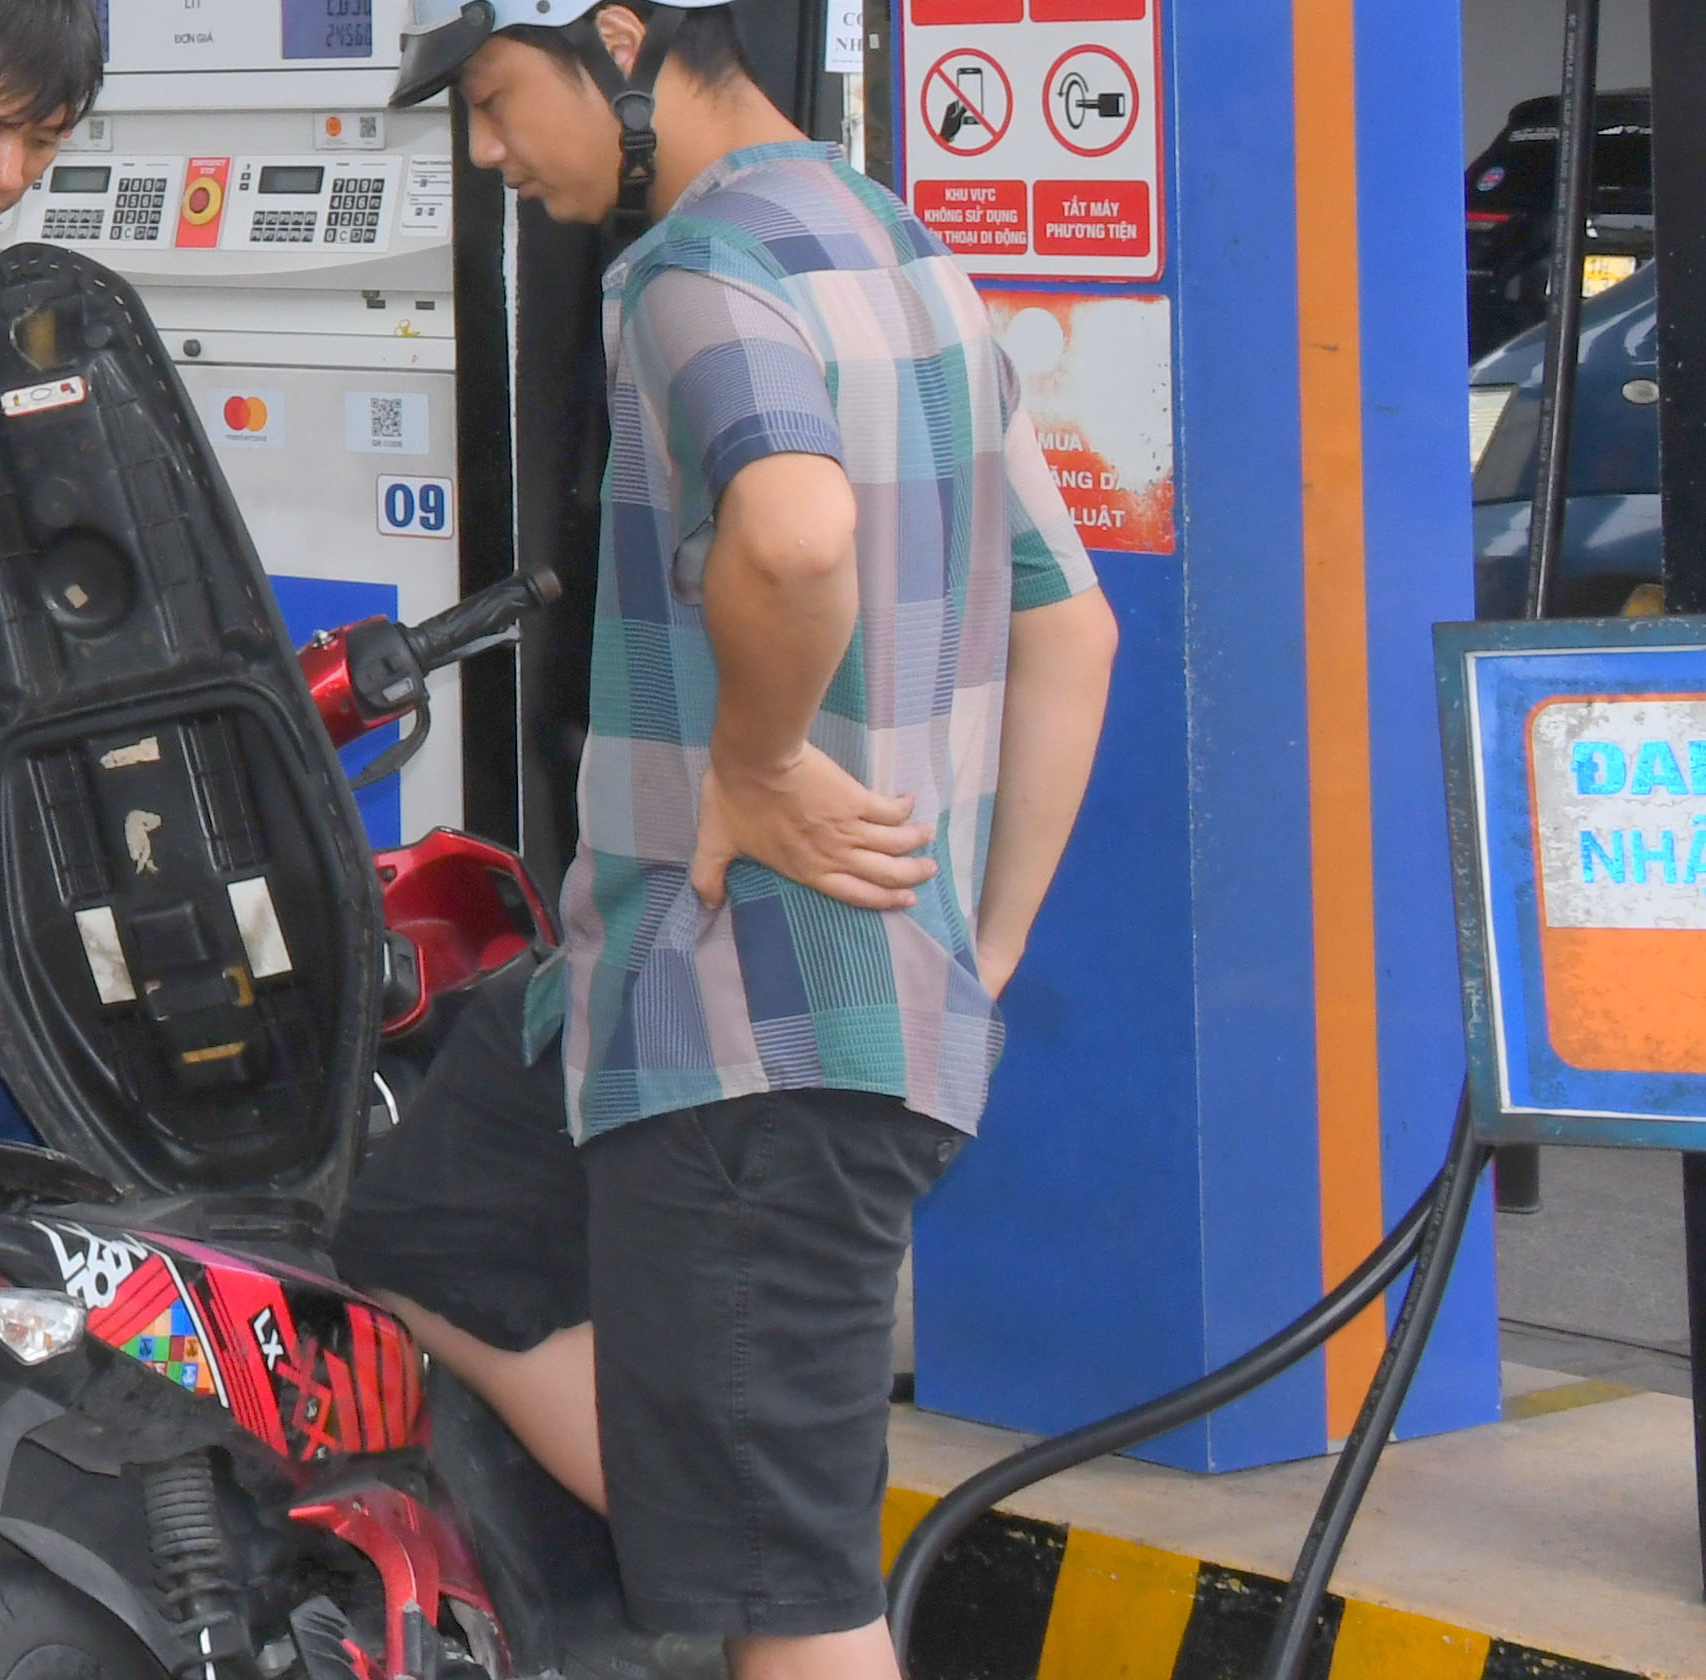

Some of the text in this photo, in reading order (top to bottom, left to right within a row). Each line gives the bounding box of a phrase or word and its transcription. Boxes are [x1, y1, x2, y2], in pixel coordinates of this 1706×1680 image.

[945, 187, 996, 203] KHU VỰC
[924, 206, 1017, 225] KHÔNG SỬ DỤNG
[1062, 198, 1120, 218] TẮT MÁY
[945, 228, 1027, 246] THOẠI DI ĐỘNG
[1046, 221, 1137, 241] PHƯƠNG TIỆN
[1038, 432, 1083, 453] MUA
[385, 483, 445, 531] 09
[1071, 506, 1125, 528] LUẬT
